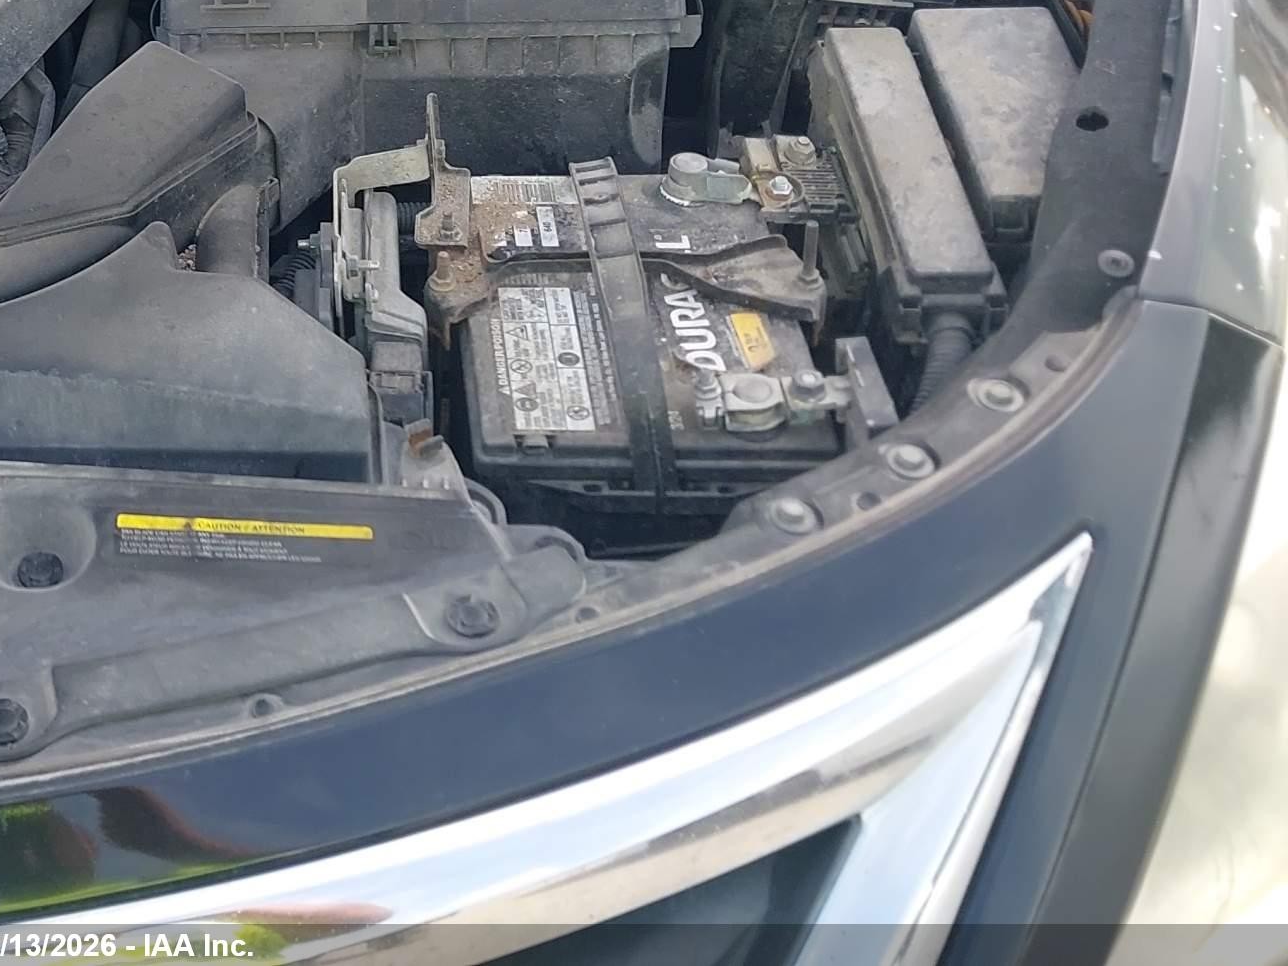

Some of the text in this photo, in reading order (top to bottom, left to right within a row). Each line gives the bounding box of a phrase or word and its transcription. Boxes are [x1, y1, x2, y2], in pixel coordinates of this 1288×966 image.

[491, 318, 508, 386] DANGER POISON
[197, 521, 241, 531] CAUTION
[253, 523, 304, 534] ATTENTION
